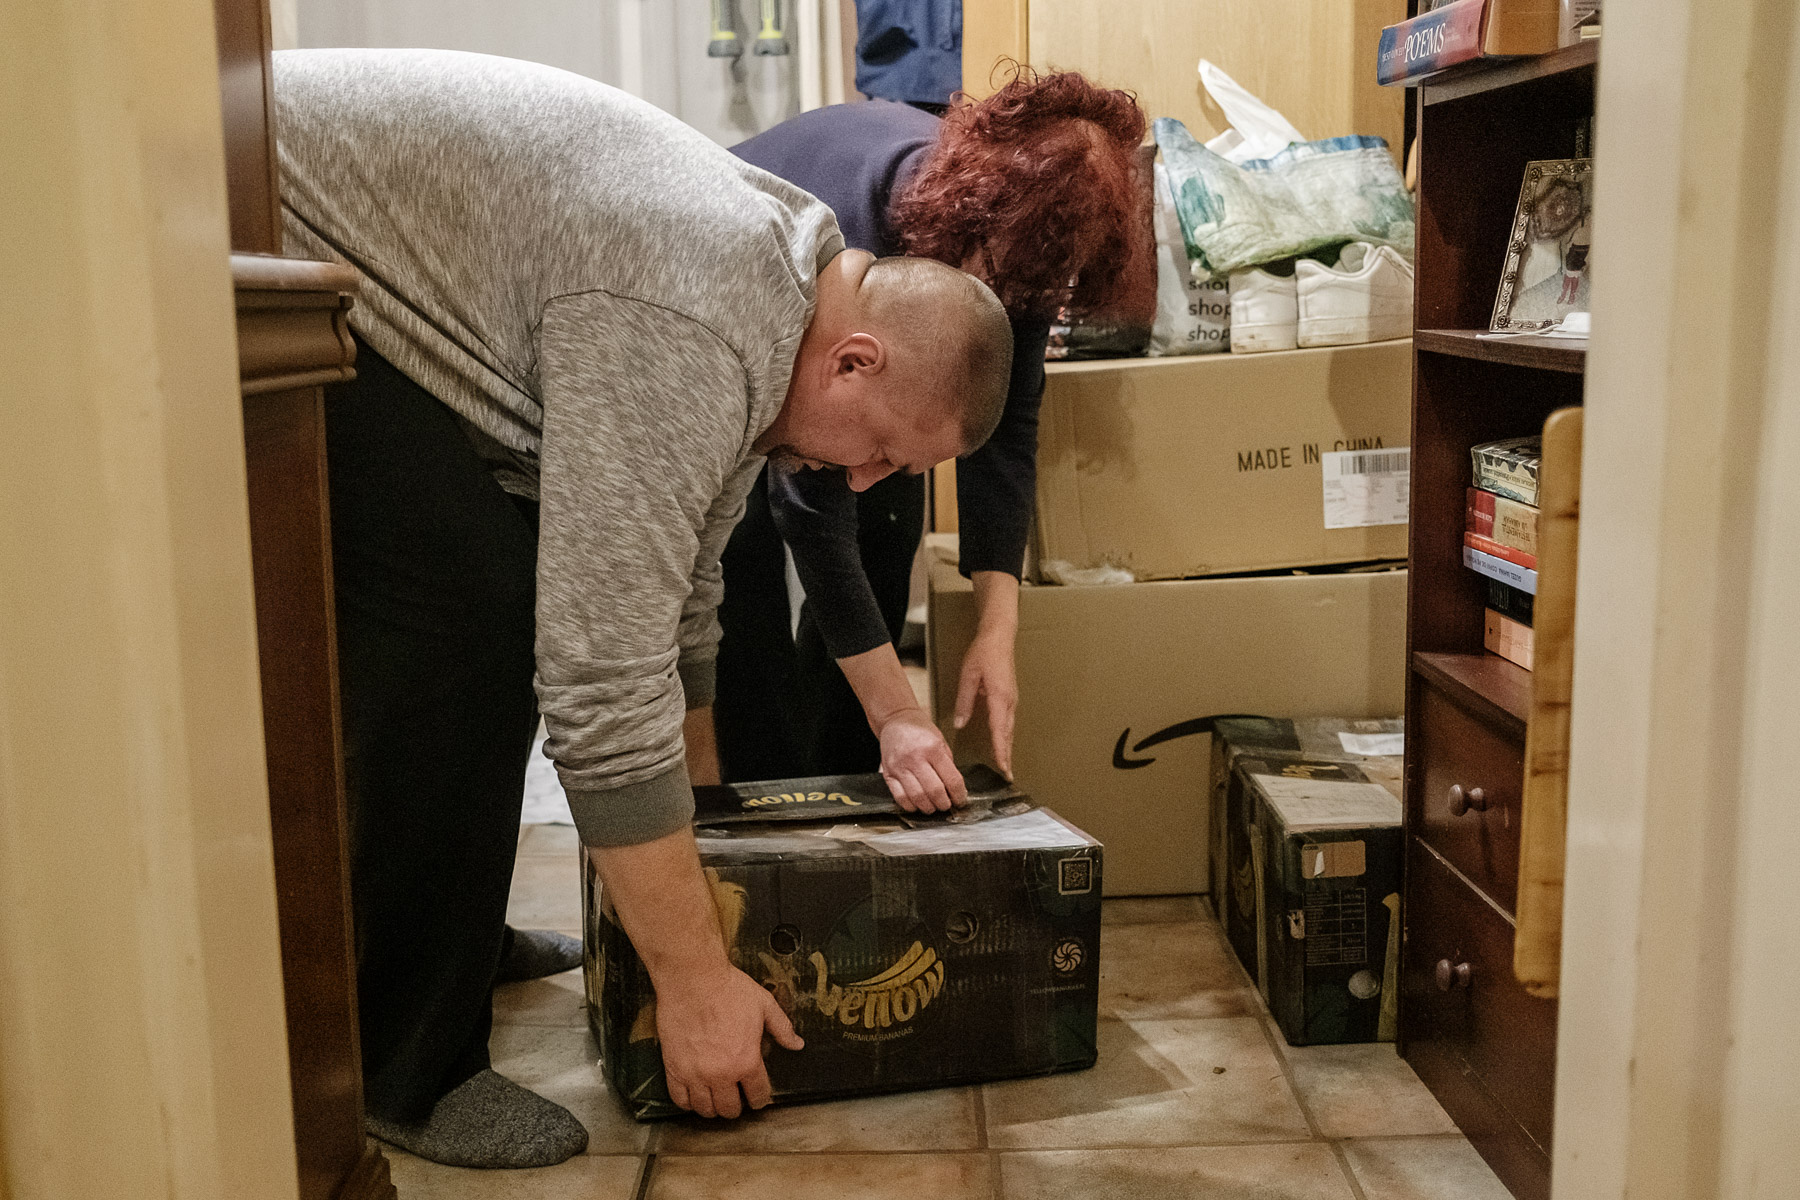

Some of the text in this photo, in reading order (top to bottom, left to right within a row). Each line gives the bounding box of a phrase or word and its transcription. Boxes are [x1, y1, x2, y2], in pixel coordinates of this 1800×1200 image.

[1403, 22, 1447, 63] POEMS
[1237, 447, 1292, 472] MADE
[1303, 443, 1320, 464] IN
[842, 1026, 914, 1042] PREMIUM BANANAS
